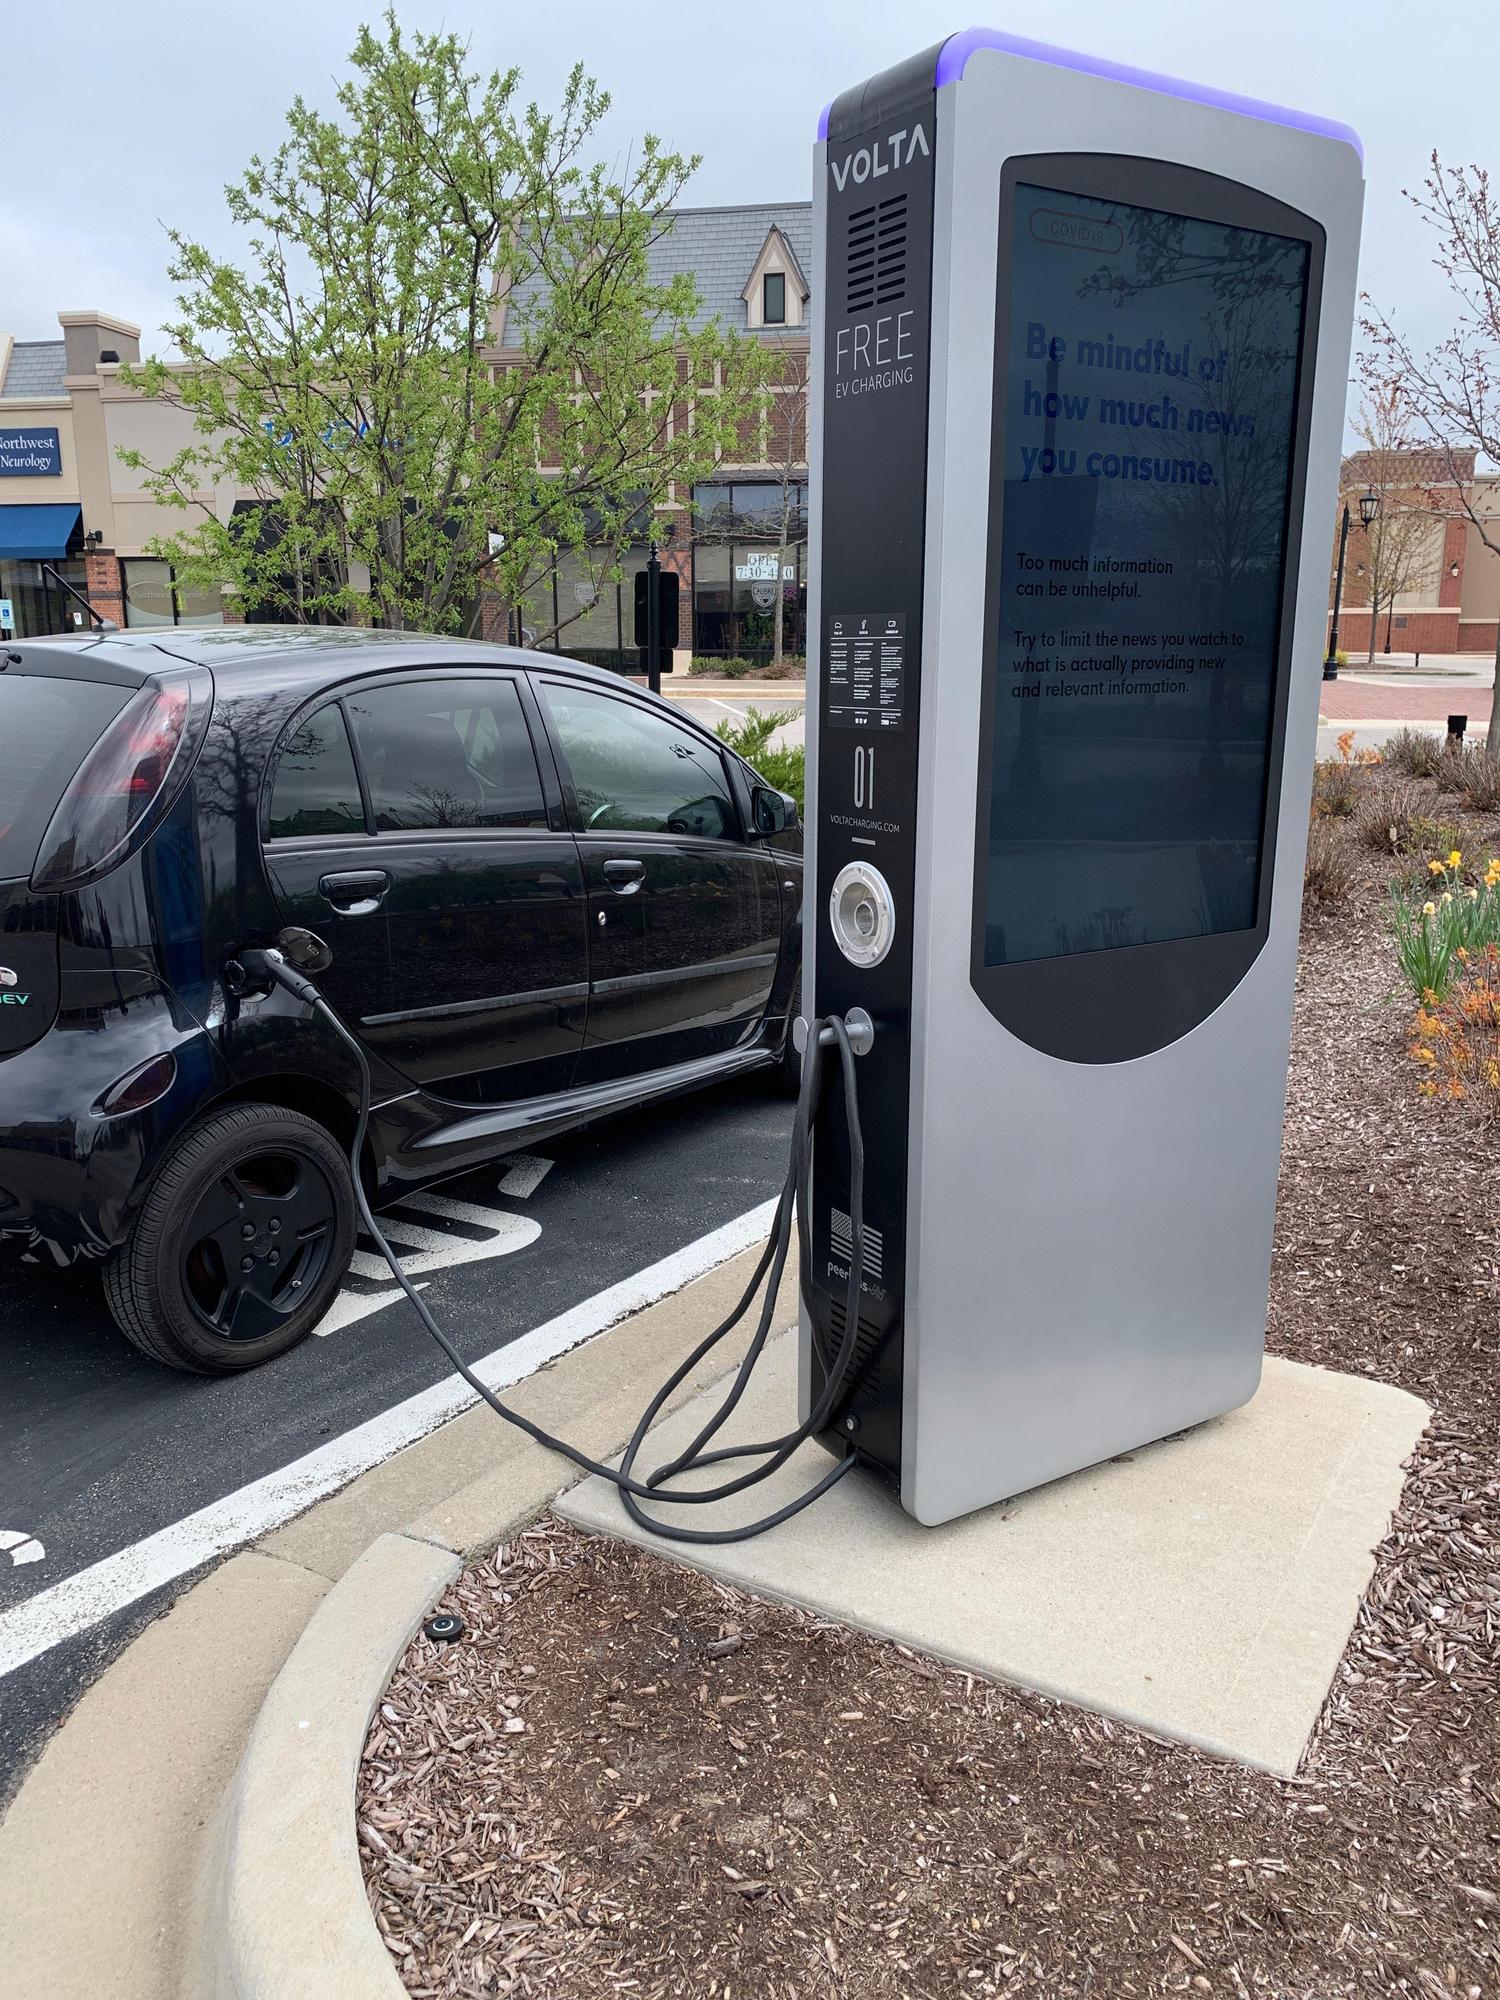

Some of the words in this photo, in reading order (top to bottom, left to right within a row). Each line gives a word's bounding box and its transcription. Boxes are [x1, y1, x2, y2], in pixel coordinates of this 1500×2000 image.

[831, 123, 930, 192] VOLTA
[1050, 220, 1090, 241] COVID
[836, 310, 914, 375] FREE
[1026, 321, 1067, 363] Be
[1078, 332, 1191, 377] mindful
[1199, 348, 1227, 384] of
[836, 382, 849, 399] EV
[851, 367, 913, 395] CHARGING
[1023, 379, 1090, 421] how
[1100, 395, 1178, 430] much
[1187, 408, 1256, 438] news
[0, 453, 51, 470] Neurology
[1020, 446, 1077, 483] you
[1086, 451, 1219, 487] consume.
[1016, 552, 1044, 571] Too
[1049, 554, 1088, 572] much
[1093, 556, 1173, 574] information
[1016, 583, 1043, 597] can
[1049, 580, 1067, 597] be
[1072, 581, 1141, 601] unhelpful.
[1014, 630, 1036, 652] Try
[1041, 632, 1056, 647] to
[1060, 630, 1091, 647] limit
[1095, 630, 1118, 647] the
[1122, 633, 1157, 647] news
[1161, 634, 1185, 650] you
[1189, 631, 1228, 647] watch
[1231, 631, 1244, 646] to
[1012, 656, 1050, 673] what
[1055, 656, 1066, 672] is
[1070, 655, 1128, 675] actually
[1131, 654, 1195, 675] providing
[1199, 655, 1226, 670] new
[1011, 681, 1040, 698] and
[1045, 680, 1104, 697] relevant
[1108, 678, 1189, 695] information.
[854, 746, 874, 809] 01
[830, 814, 900, 833] VOLTACHARGING.COM
